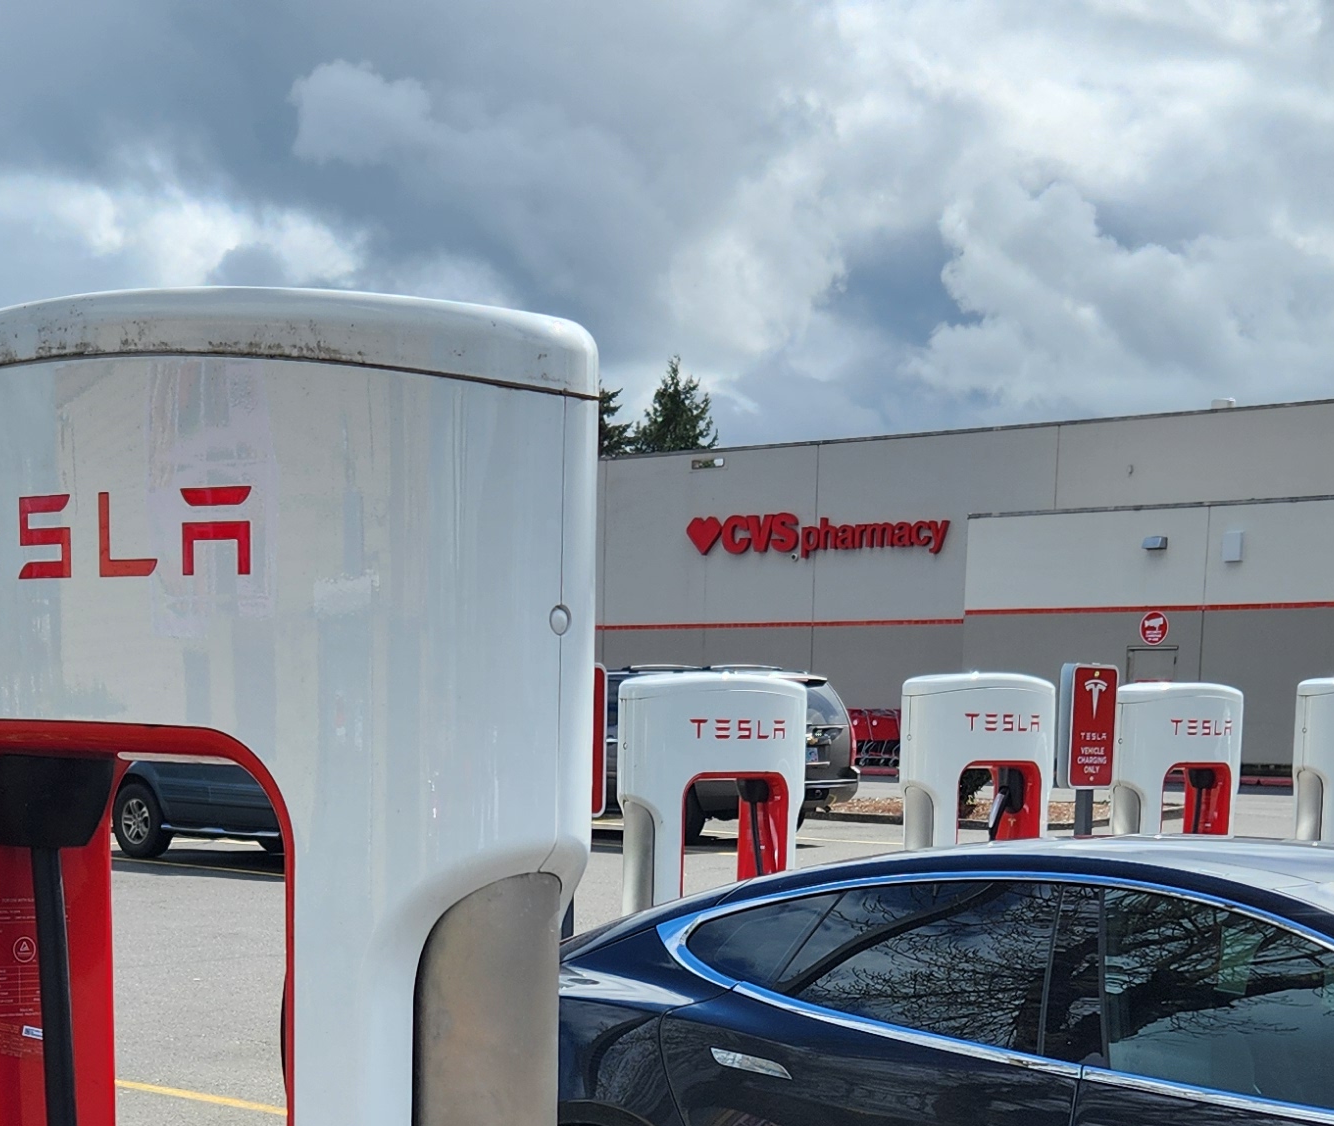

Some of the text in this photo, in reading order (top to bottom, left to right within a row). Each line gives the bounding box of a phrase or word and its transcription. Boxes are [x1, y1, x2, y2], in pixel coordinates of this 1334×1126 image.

[720, 512, 950, 559] CVS pharmacy
[965, 712, 1040, 732] TESLA
[1170, 719, 1232, 736] TESLA
[690, 718, 786, 740] TESLA
[1080, 732, 1107, 741] TESLA
[1080, 747, 1105, 756] VEHICLE
[1077, 756, 1107, 765] CHARGING
[1083, 765, 1100, 774] ONLY
